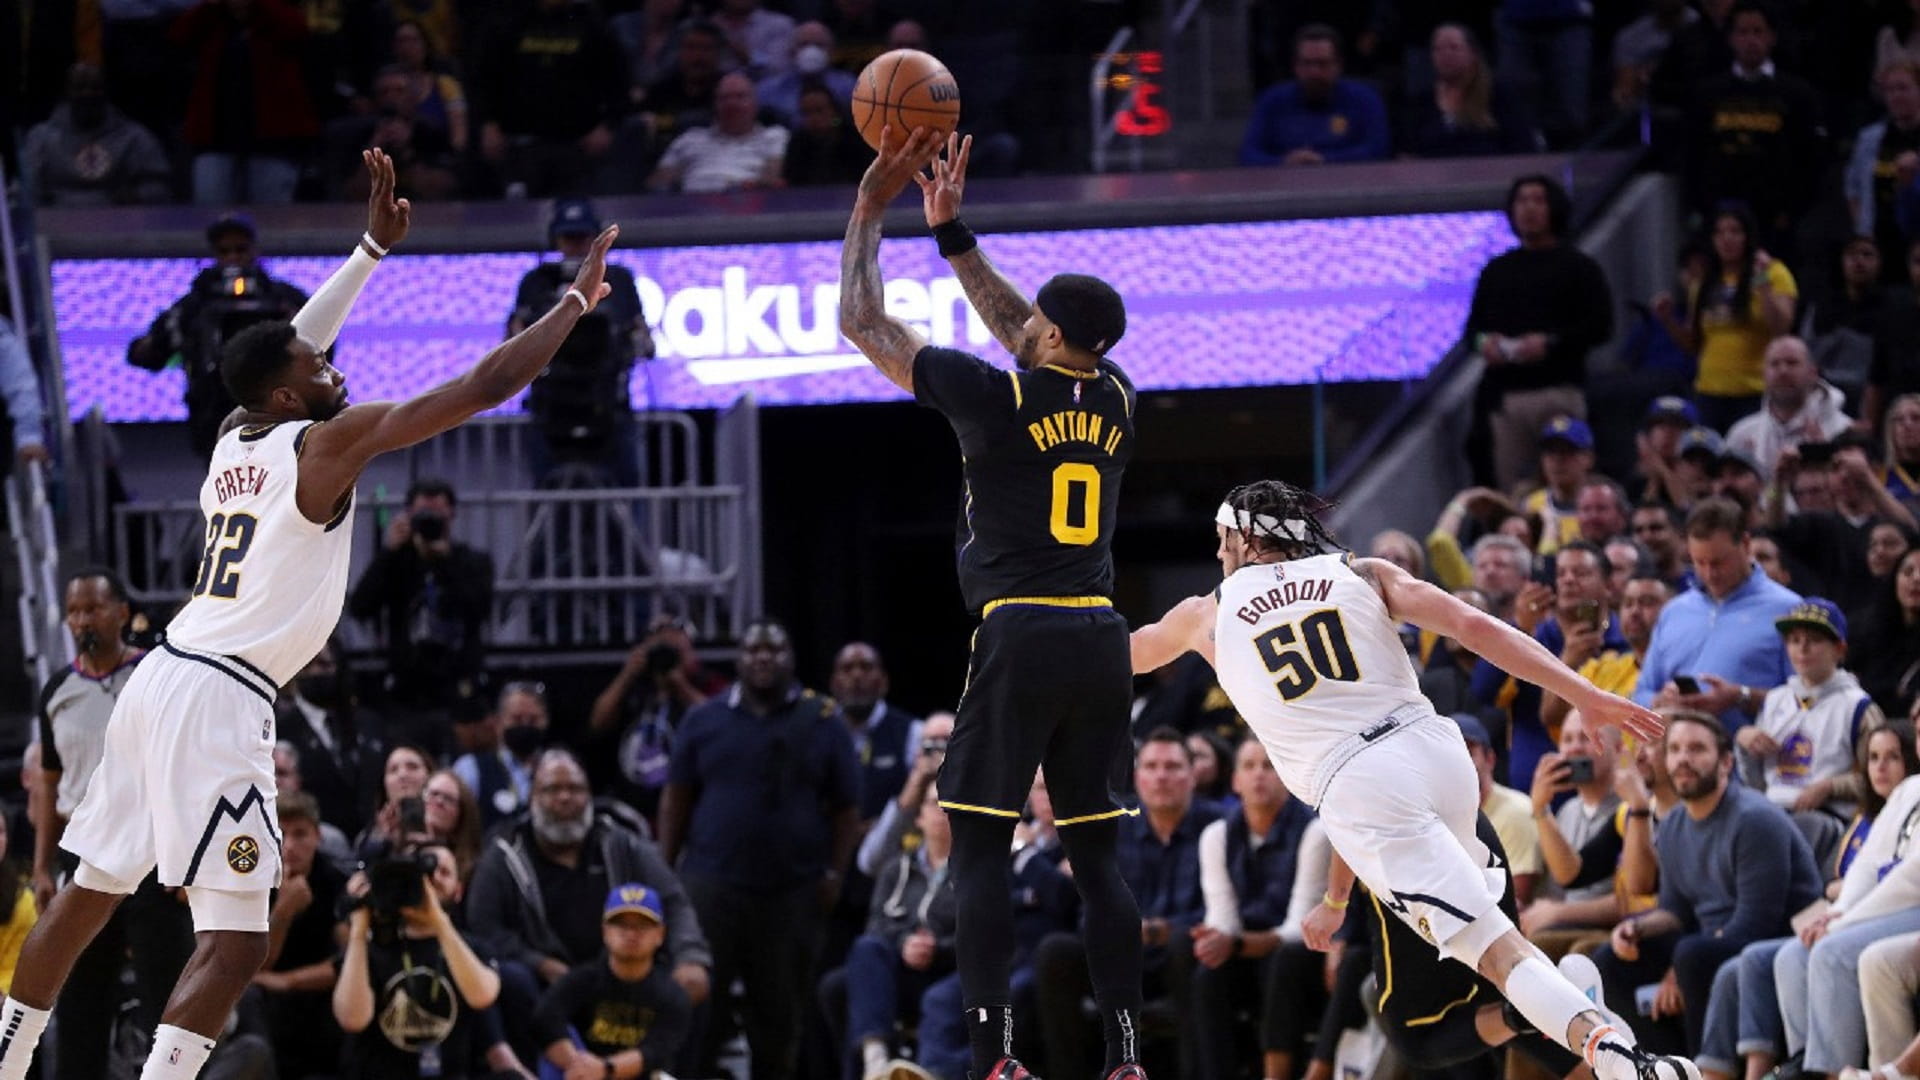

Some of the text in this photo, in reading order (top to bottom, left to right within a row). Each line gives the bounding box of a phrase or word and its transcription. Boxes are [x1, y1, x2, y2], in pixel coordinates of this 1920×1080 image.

[635, 265, 991, 359] akuen
[1028, 410, 1123, 456] PAYTON II
[214, 465, 269, 505] GREEN
[1050, 462, 1101, 546] 0
[192, 508, 260, 601] 32
[1236, 579, 1334, 626] GORDON
[1252, 607, 1362, 703] 50
